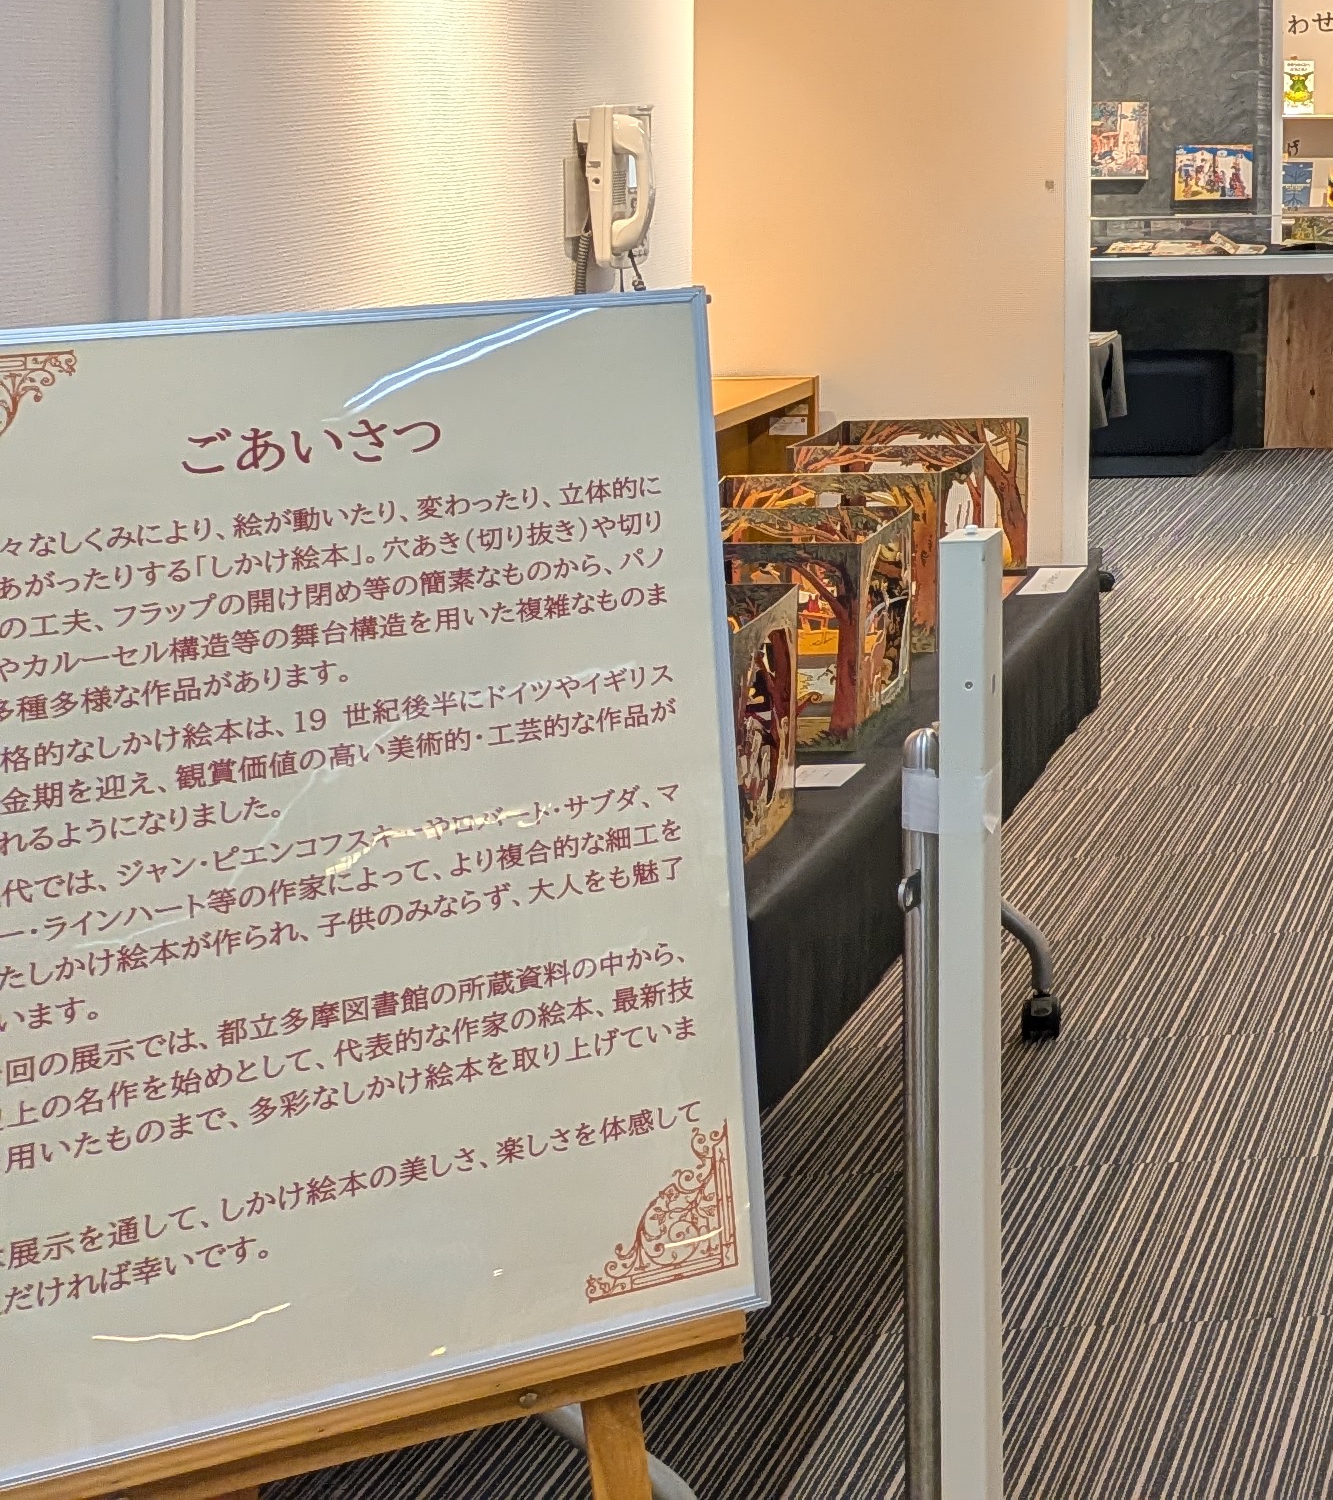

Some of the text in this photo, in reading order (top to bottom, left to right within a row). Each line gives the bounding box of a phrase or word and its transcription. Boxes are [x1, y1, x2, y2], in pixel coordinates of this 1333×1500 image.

[181, 418, 441, 476] ごあいさつ
[2, 474, 663, 557] 々なしくみにより、絵が動いたり、変わったり、立体的に
[0, 546, 665, 639] の工夫、フラップの開け閉め等の簡素なものから、パノ
[0, 582, 668, 682] やカルーセル構造等の舞台構造を用いた複雑なものま
[0, 699, 676, 815] 金期を迎え、観賞価値の高い美術的・工芸的な作品が
[0, 796, 282, 855] れるようになりました。
[0, 856, 684, 990] たしかけ絵本が作られ、子供のみならず、大人をも魅了
[0, 942, 688, 1087] 回の展示では、都立多摩図書館の所蔵資料の中から、
[0, 978, 695, 1130] 上の名作を始めとして、代表的な作家の絵本、最新技
[5, 1016, 697, 1173] 用いたものまで、多彩なしかけ絵本を取り上げていま
[0, 1100, 702, 1270] 展示を通して、しかけ絵本の美しさ、楽しさを体感して
[0, 1236, 269, 1314] だければ幸いです。
